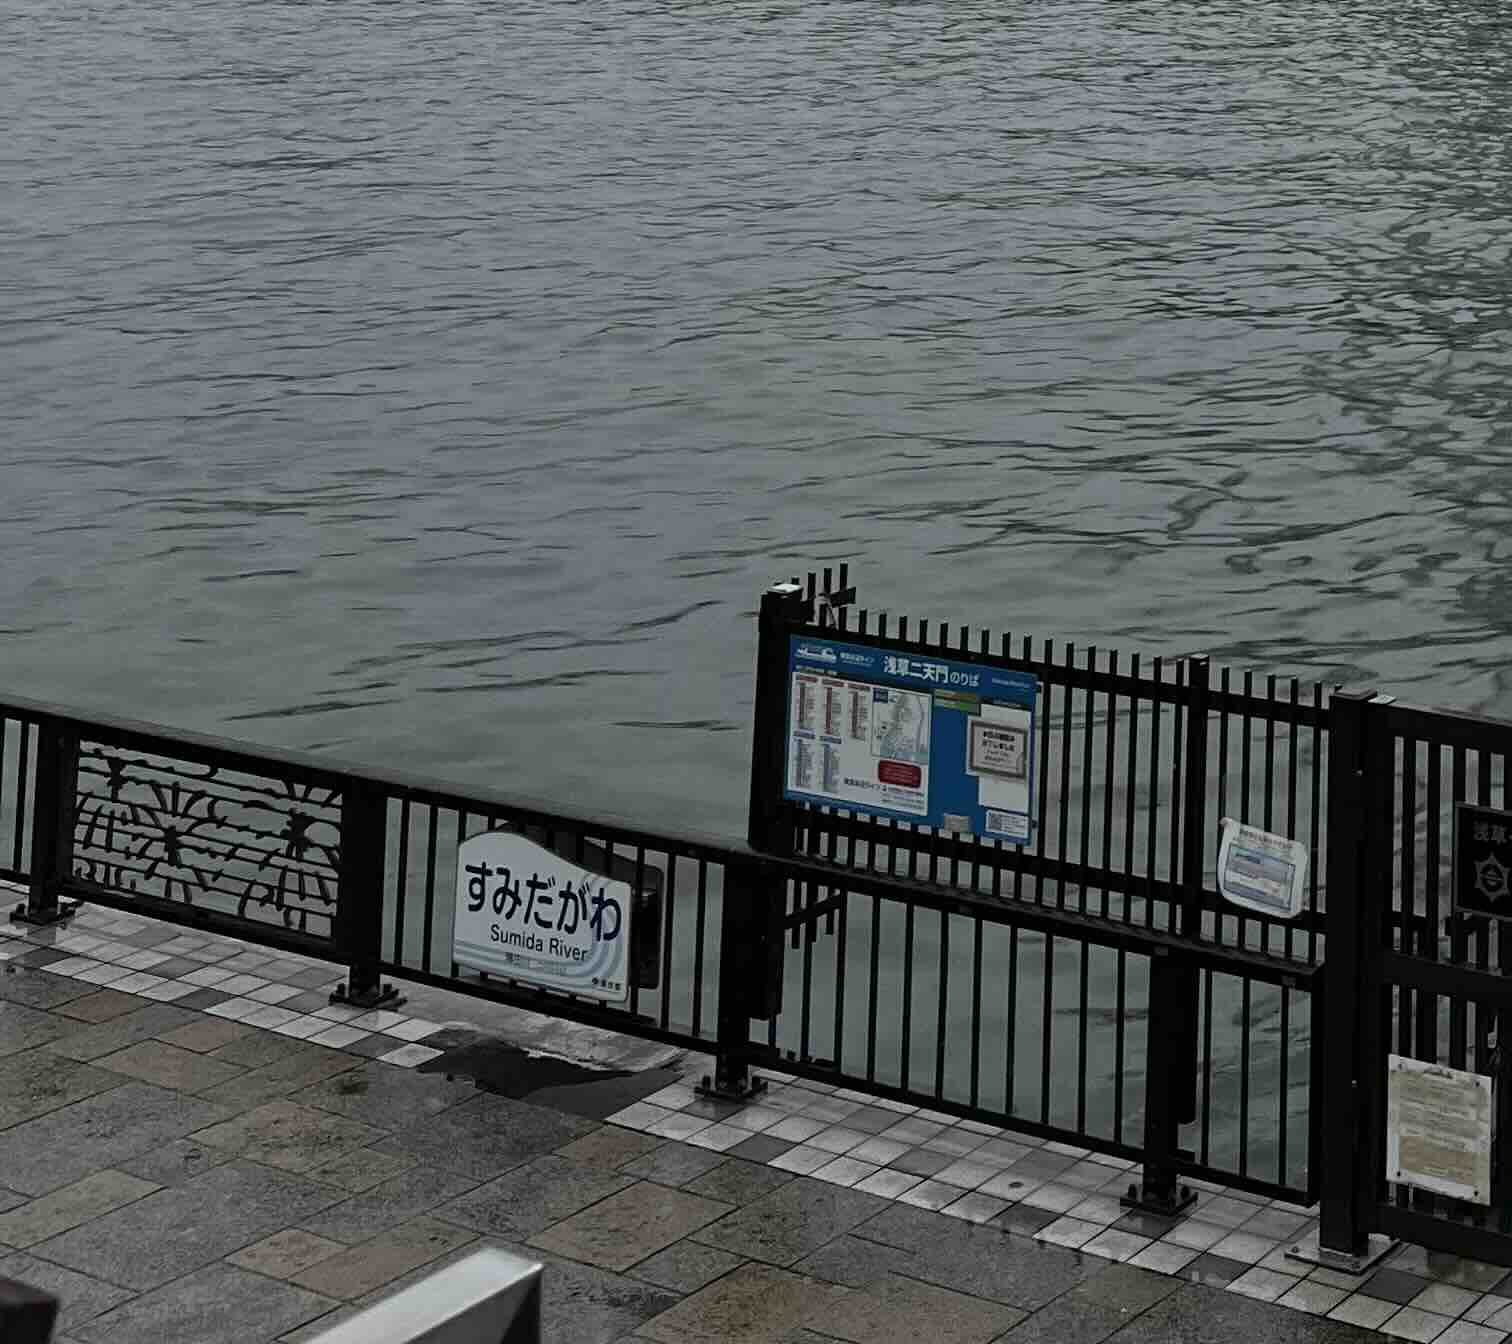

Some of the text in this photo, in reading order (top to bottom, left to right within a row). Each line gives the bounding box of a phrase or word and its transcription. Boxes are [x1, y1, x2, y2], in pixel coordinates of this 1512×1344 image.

[465, 861, 622, 942] すみだがわ
[490, 923, 589, 961] Sumida River
